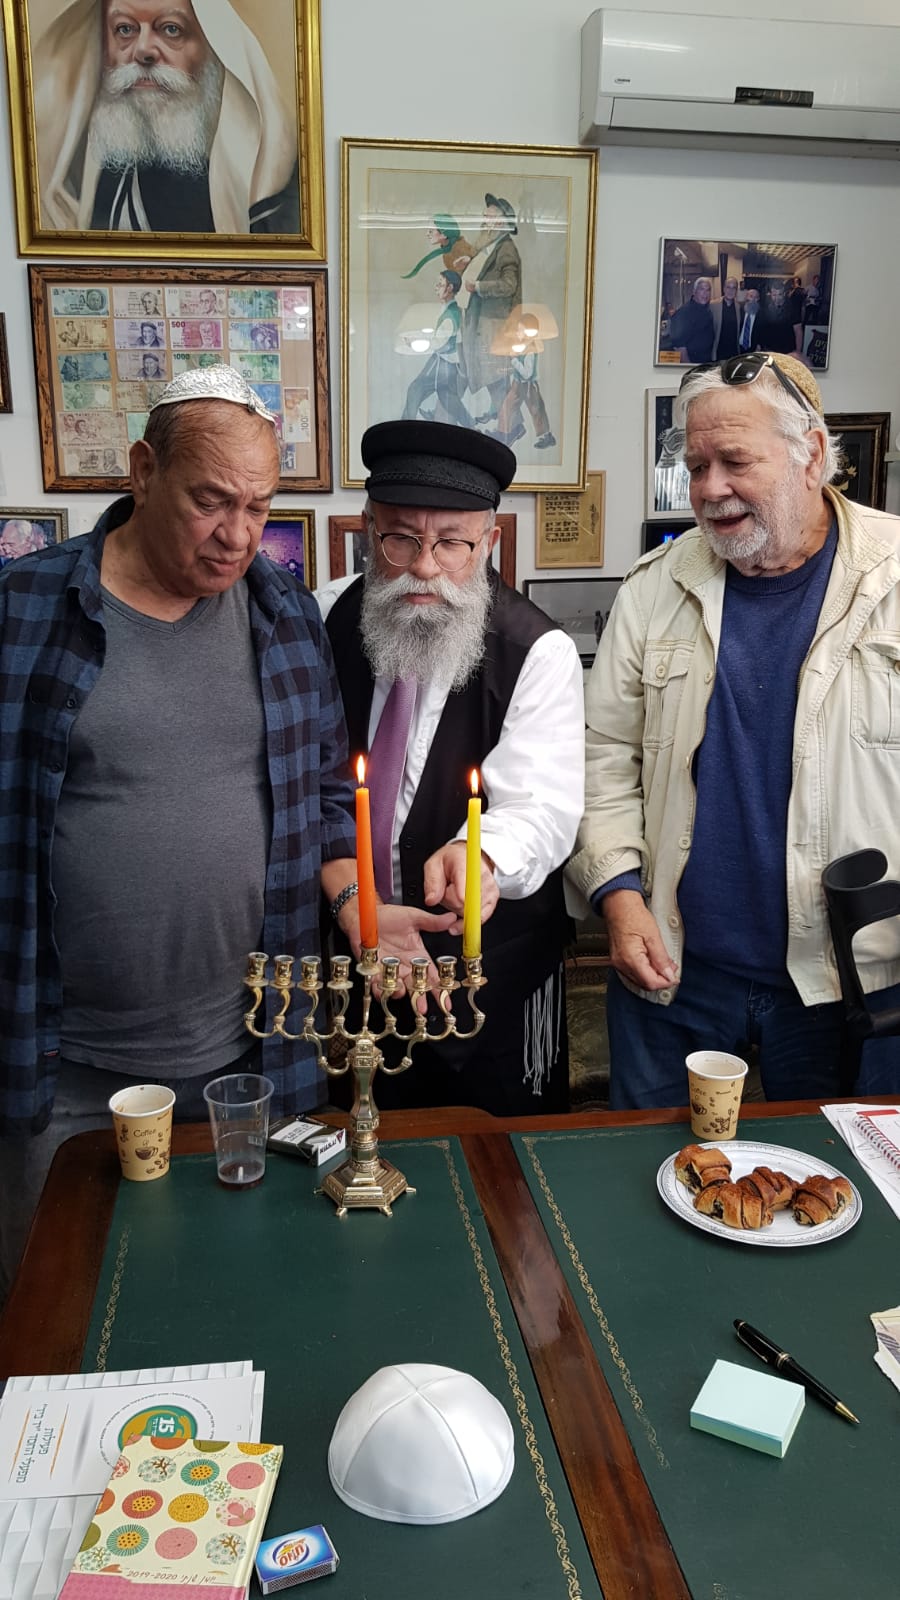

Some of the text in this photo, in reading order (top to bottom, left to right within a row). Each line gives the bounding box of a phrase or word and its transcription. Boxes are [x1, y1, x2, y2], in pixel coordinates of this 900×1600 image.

[101, 320, 107, 329] 5
[173, 353, 191, 361] 1000
[242, 369, 252, 378] 50
[158, 1416, 175, 1433] 15
[126, 1569, 178, 1581] 2019-2020
